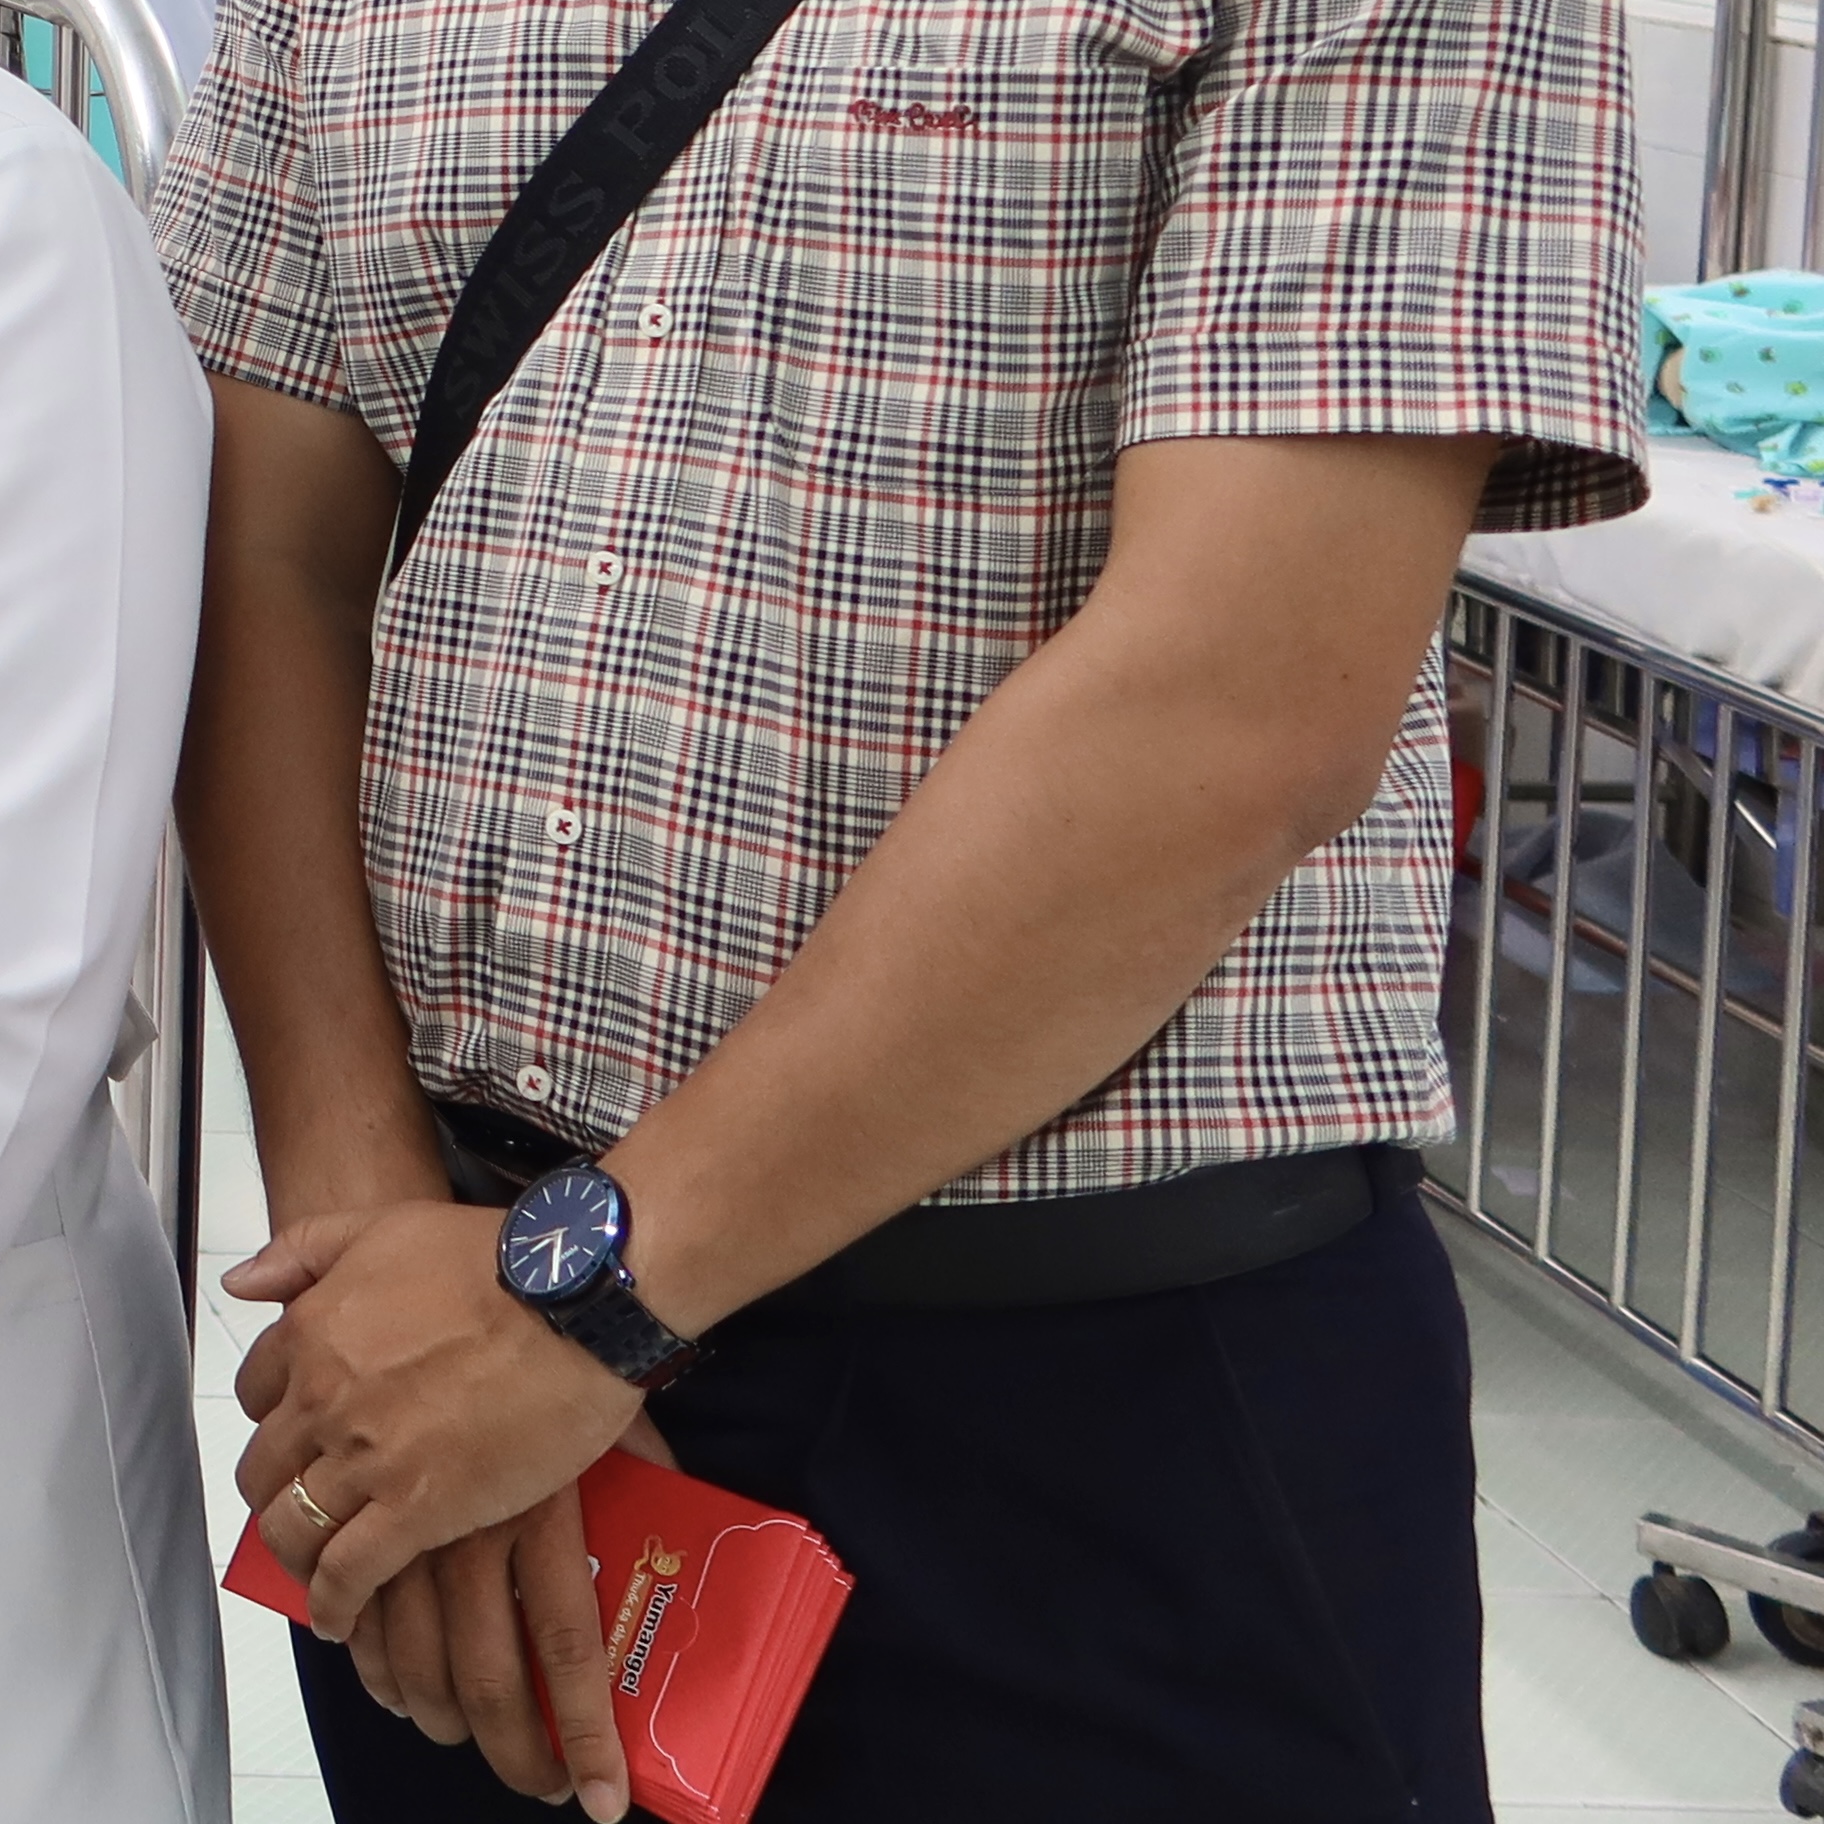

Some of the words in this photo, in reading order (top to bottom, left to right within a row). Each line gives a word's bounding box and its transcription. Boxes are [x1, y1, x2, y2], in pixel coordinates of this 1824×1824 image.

[443, 168, 605, 421] SWISS
[618, 1583, 679, 1697] Yumangel
[625, 1572, 647, 1606] Thuốc
